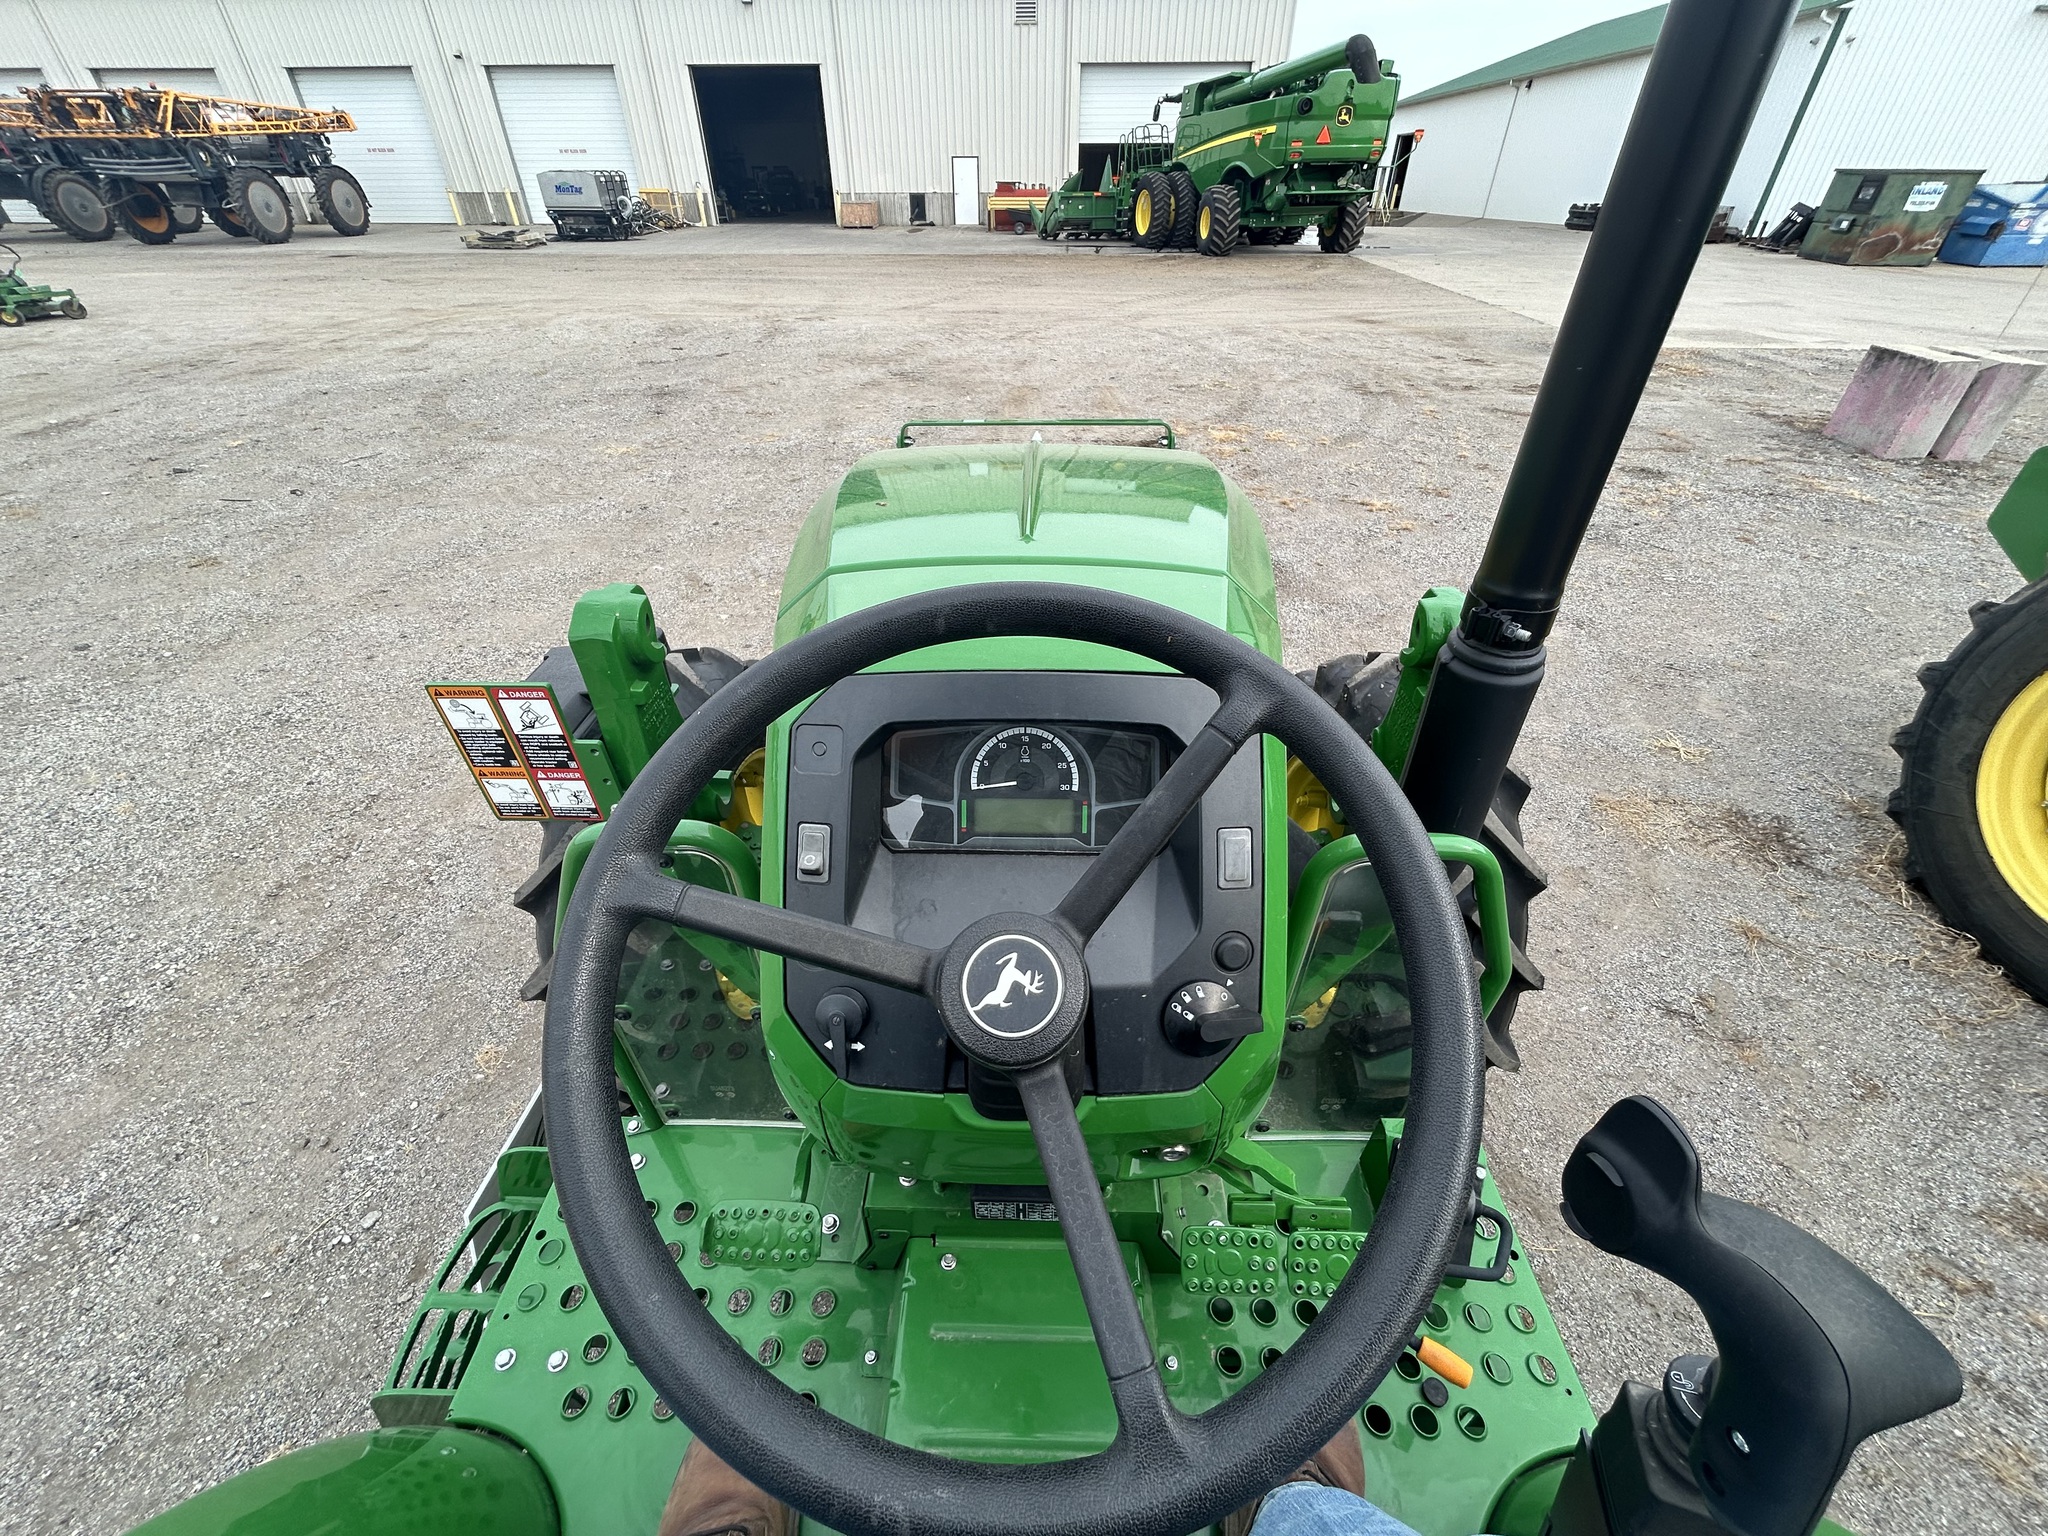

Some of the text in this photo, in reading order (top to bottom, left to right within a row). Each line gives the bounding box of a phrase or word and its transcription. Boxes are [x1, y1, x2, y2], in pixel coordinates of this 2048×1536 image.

[555, 185, 583, 195] MonTag
[1911, 187, 1944, 195] INLAND
[444, 689, 485, 697] WARNING
